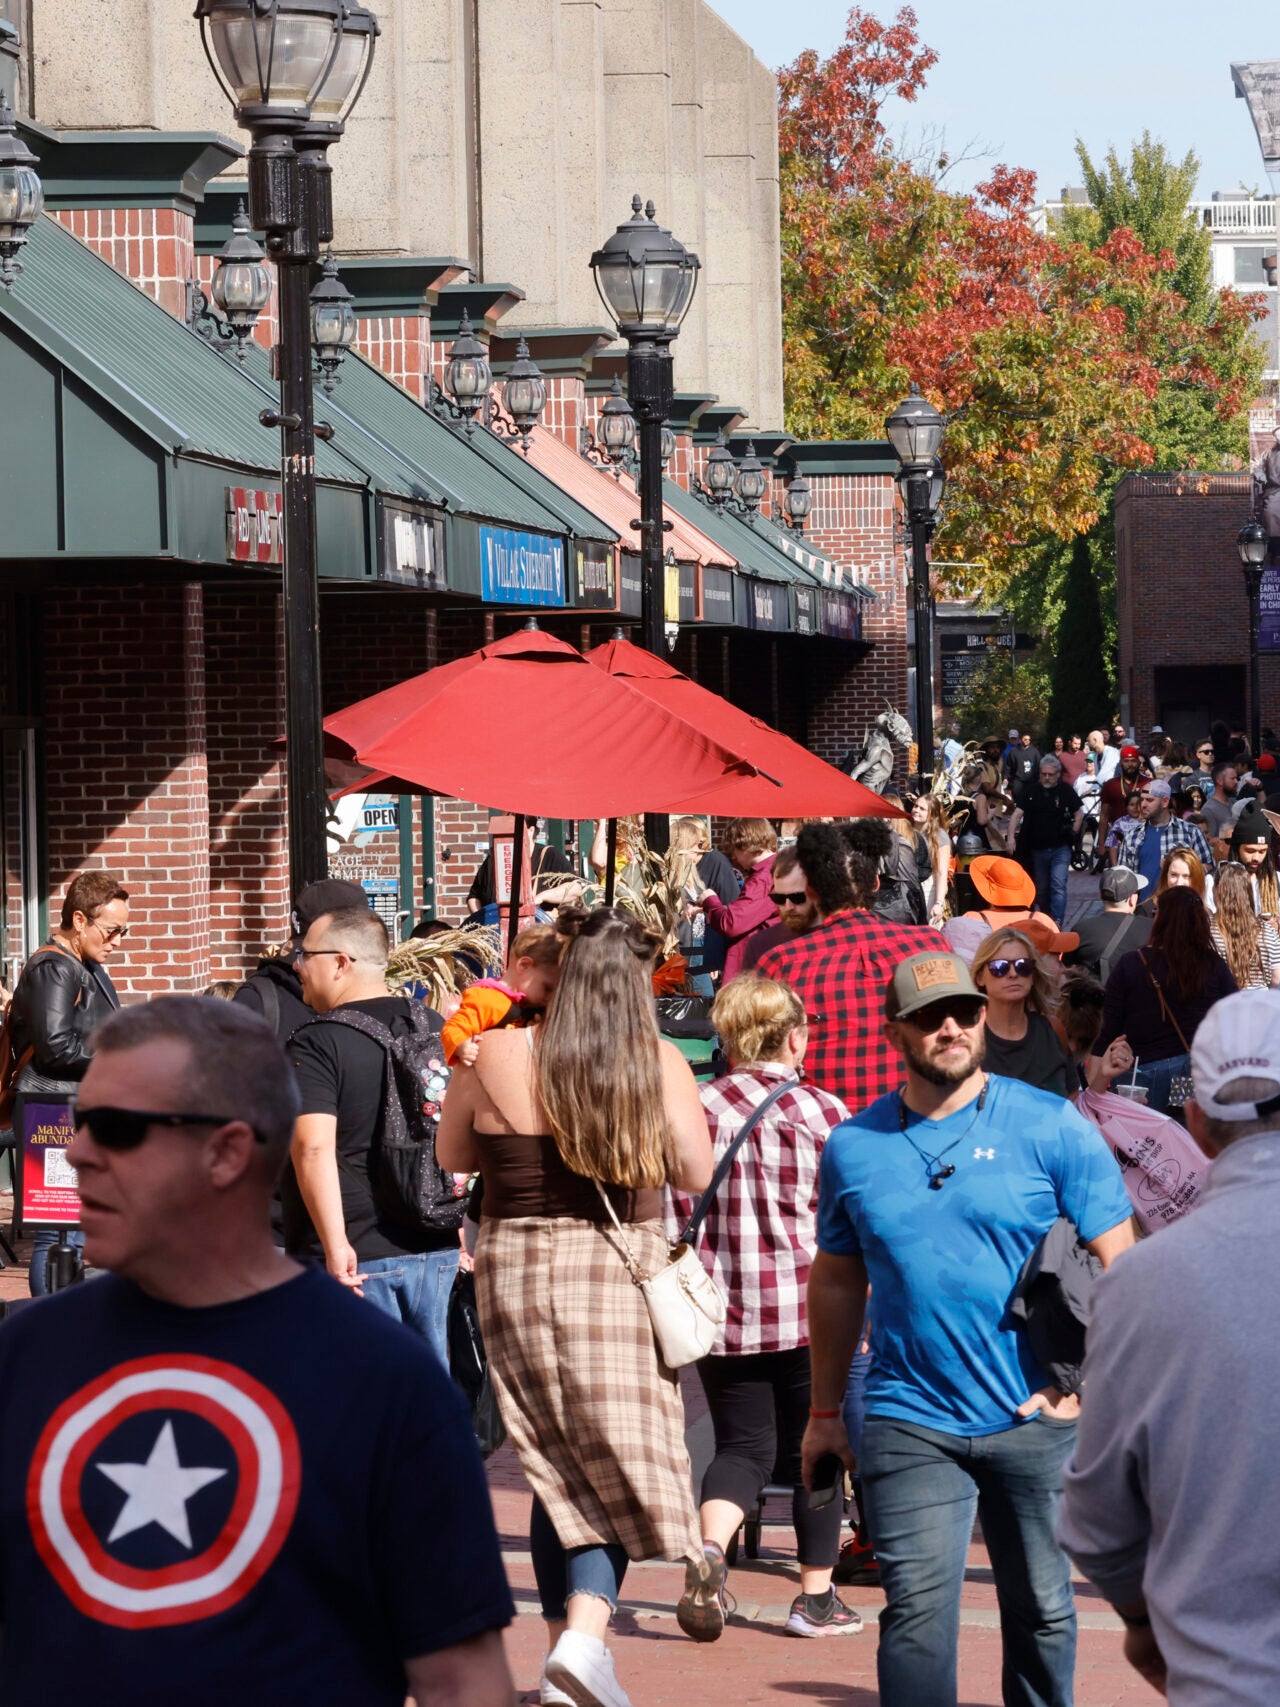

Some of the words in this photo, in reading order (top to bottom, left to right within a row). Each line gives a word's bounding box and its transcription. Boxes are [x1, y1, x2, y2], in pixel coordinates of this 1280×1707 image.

[237, 507, 249, 542] RED
[256, 509, 271, 544] LINE
[1260, 584, 1279, 592] EARLY
[1260, 601, 1267, 609] IN
[364, 809, 398, 826] OPEN
[1218, 1057, 1270, 1075] HARVARD
[1146, 1207, 1158, 1218] 226
